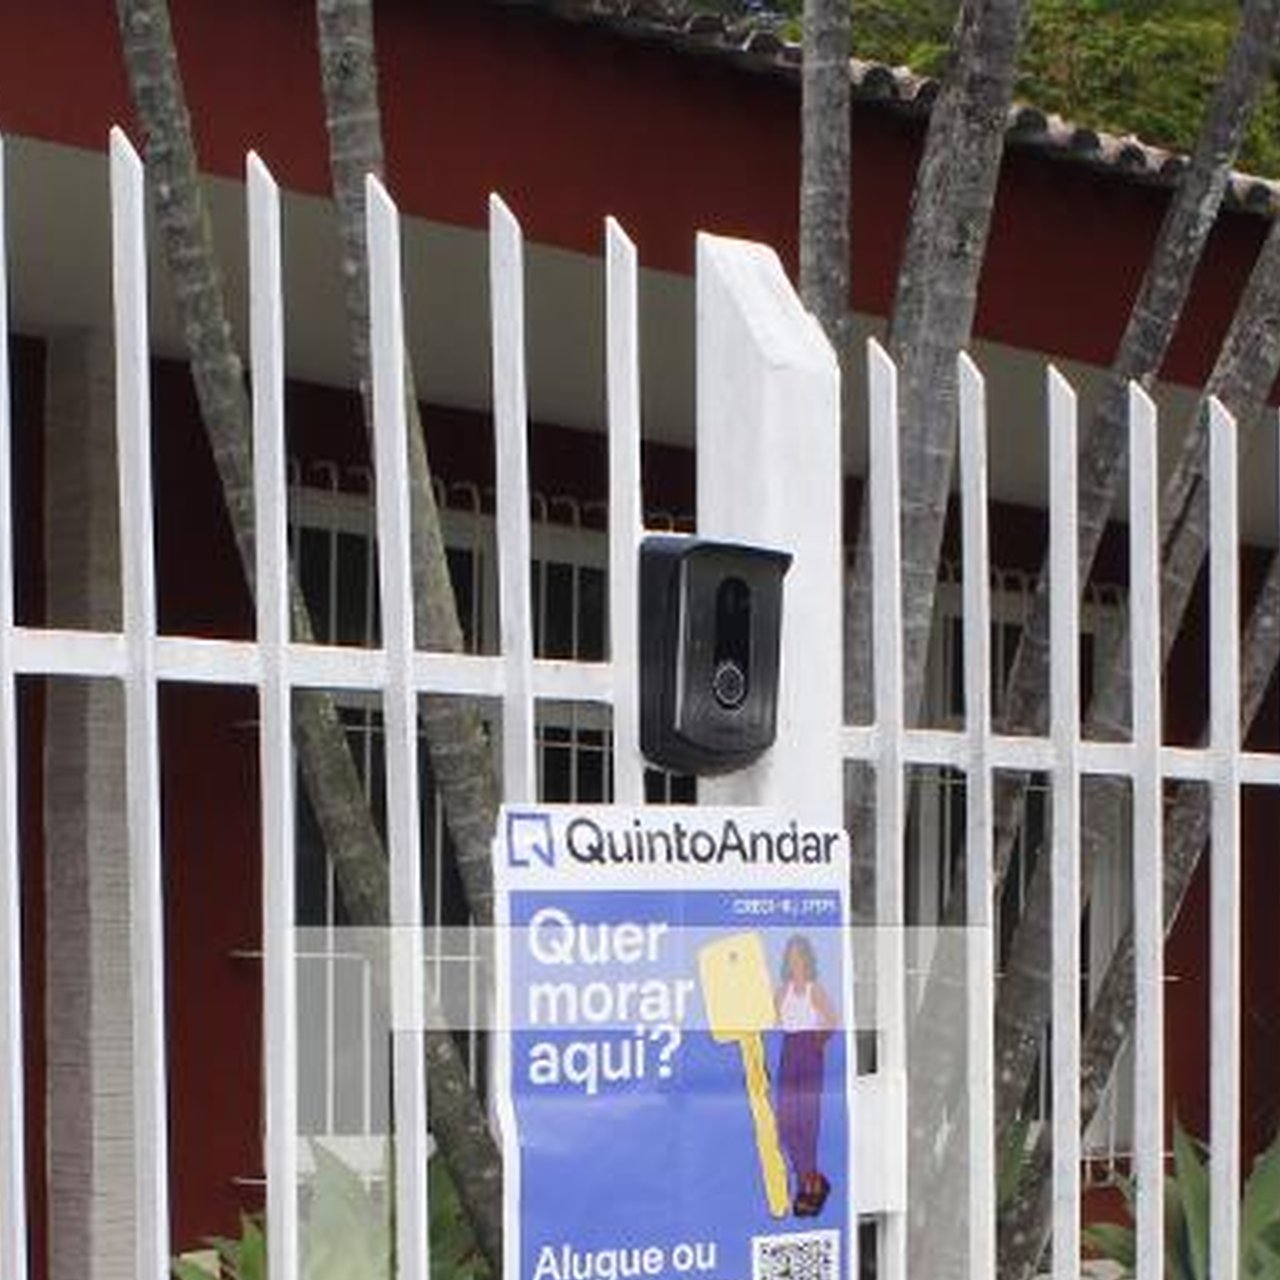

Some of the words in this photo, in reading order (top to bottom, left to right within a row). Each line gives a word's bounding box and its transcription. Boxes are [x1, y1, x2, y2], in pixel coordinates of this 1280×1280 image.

[566, 818, 839, 865] QuintoAndar
[529, 906, 668, 965] Quer
[529, 977, 695, 1025] morar
[528, 1022, 681, 1096] aqui?
[672, 1242, 718, 1273] ou
